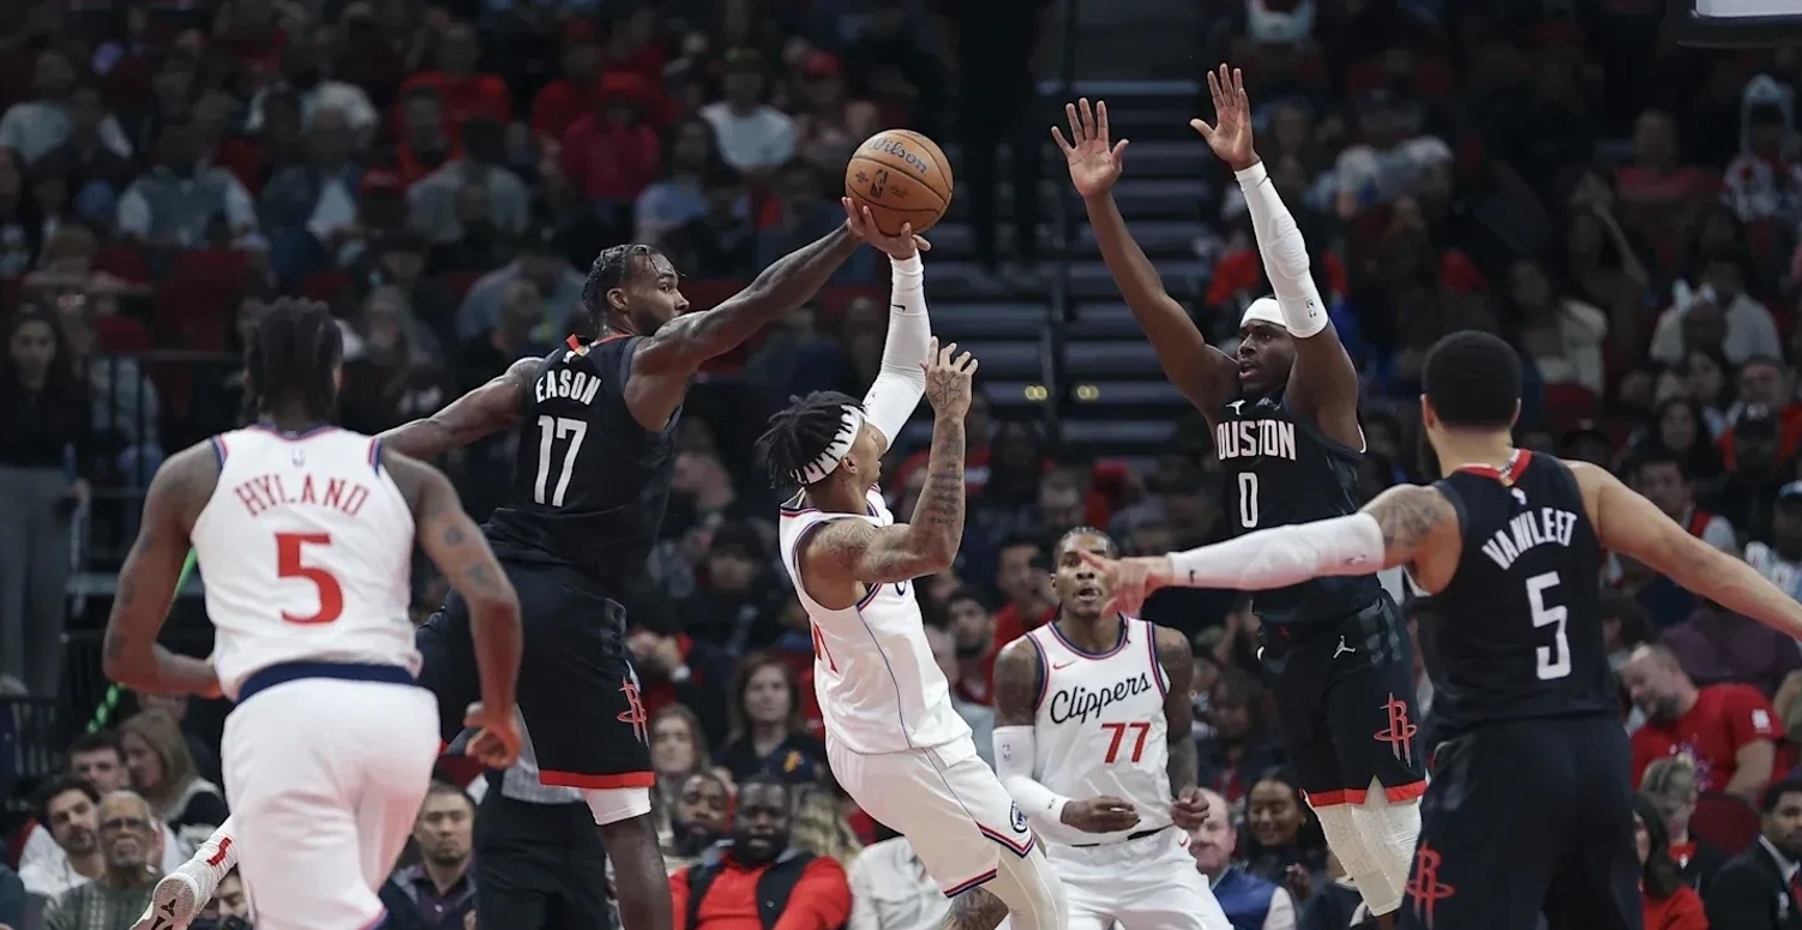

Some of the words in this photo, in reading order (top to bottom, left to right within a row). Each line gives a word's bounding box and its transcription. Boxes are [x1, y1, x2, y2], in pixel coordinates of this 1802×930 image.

[535, 369, 601, 406] EASON
[534, 415, 588, 507] 17
[1216, 419, 1297, 461] OUSTON
[234, 474, 369, 517] HYLAND
[1238, 472, 1259, 528] 0
[274, 532, 344, 625] 5
[1526, 571, 1571, 680] 5
[1050, 672, 1152, 725] Clippers
[1101, 722, 1151, 764] 77
